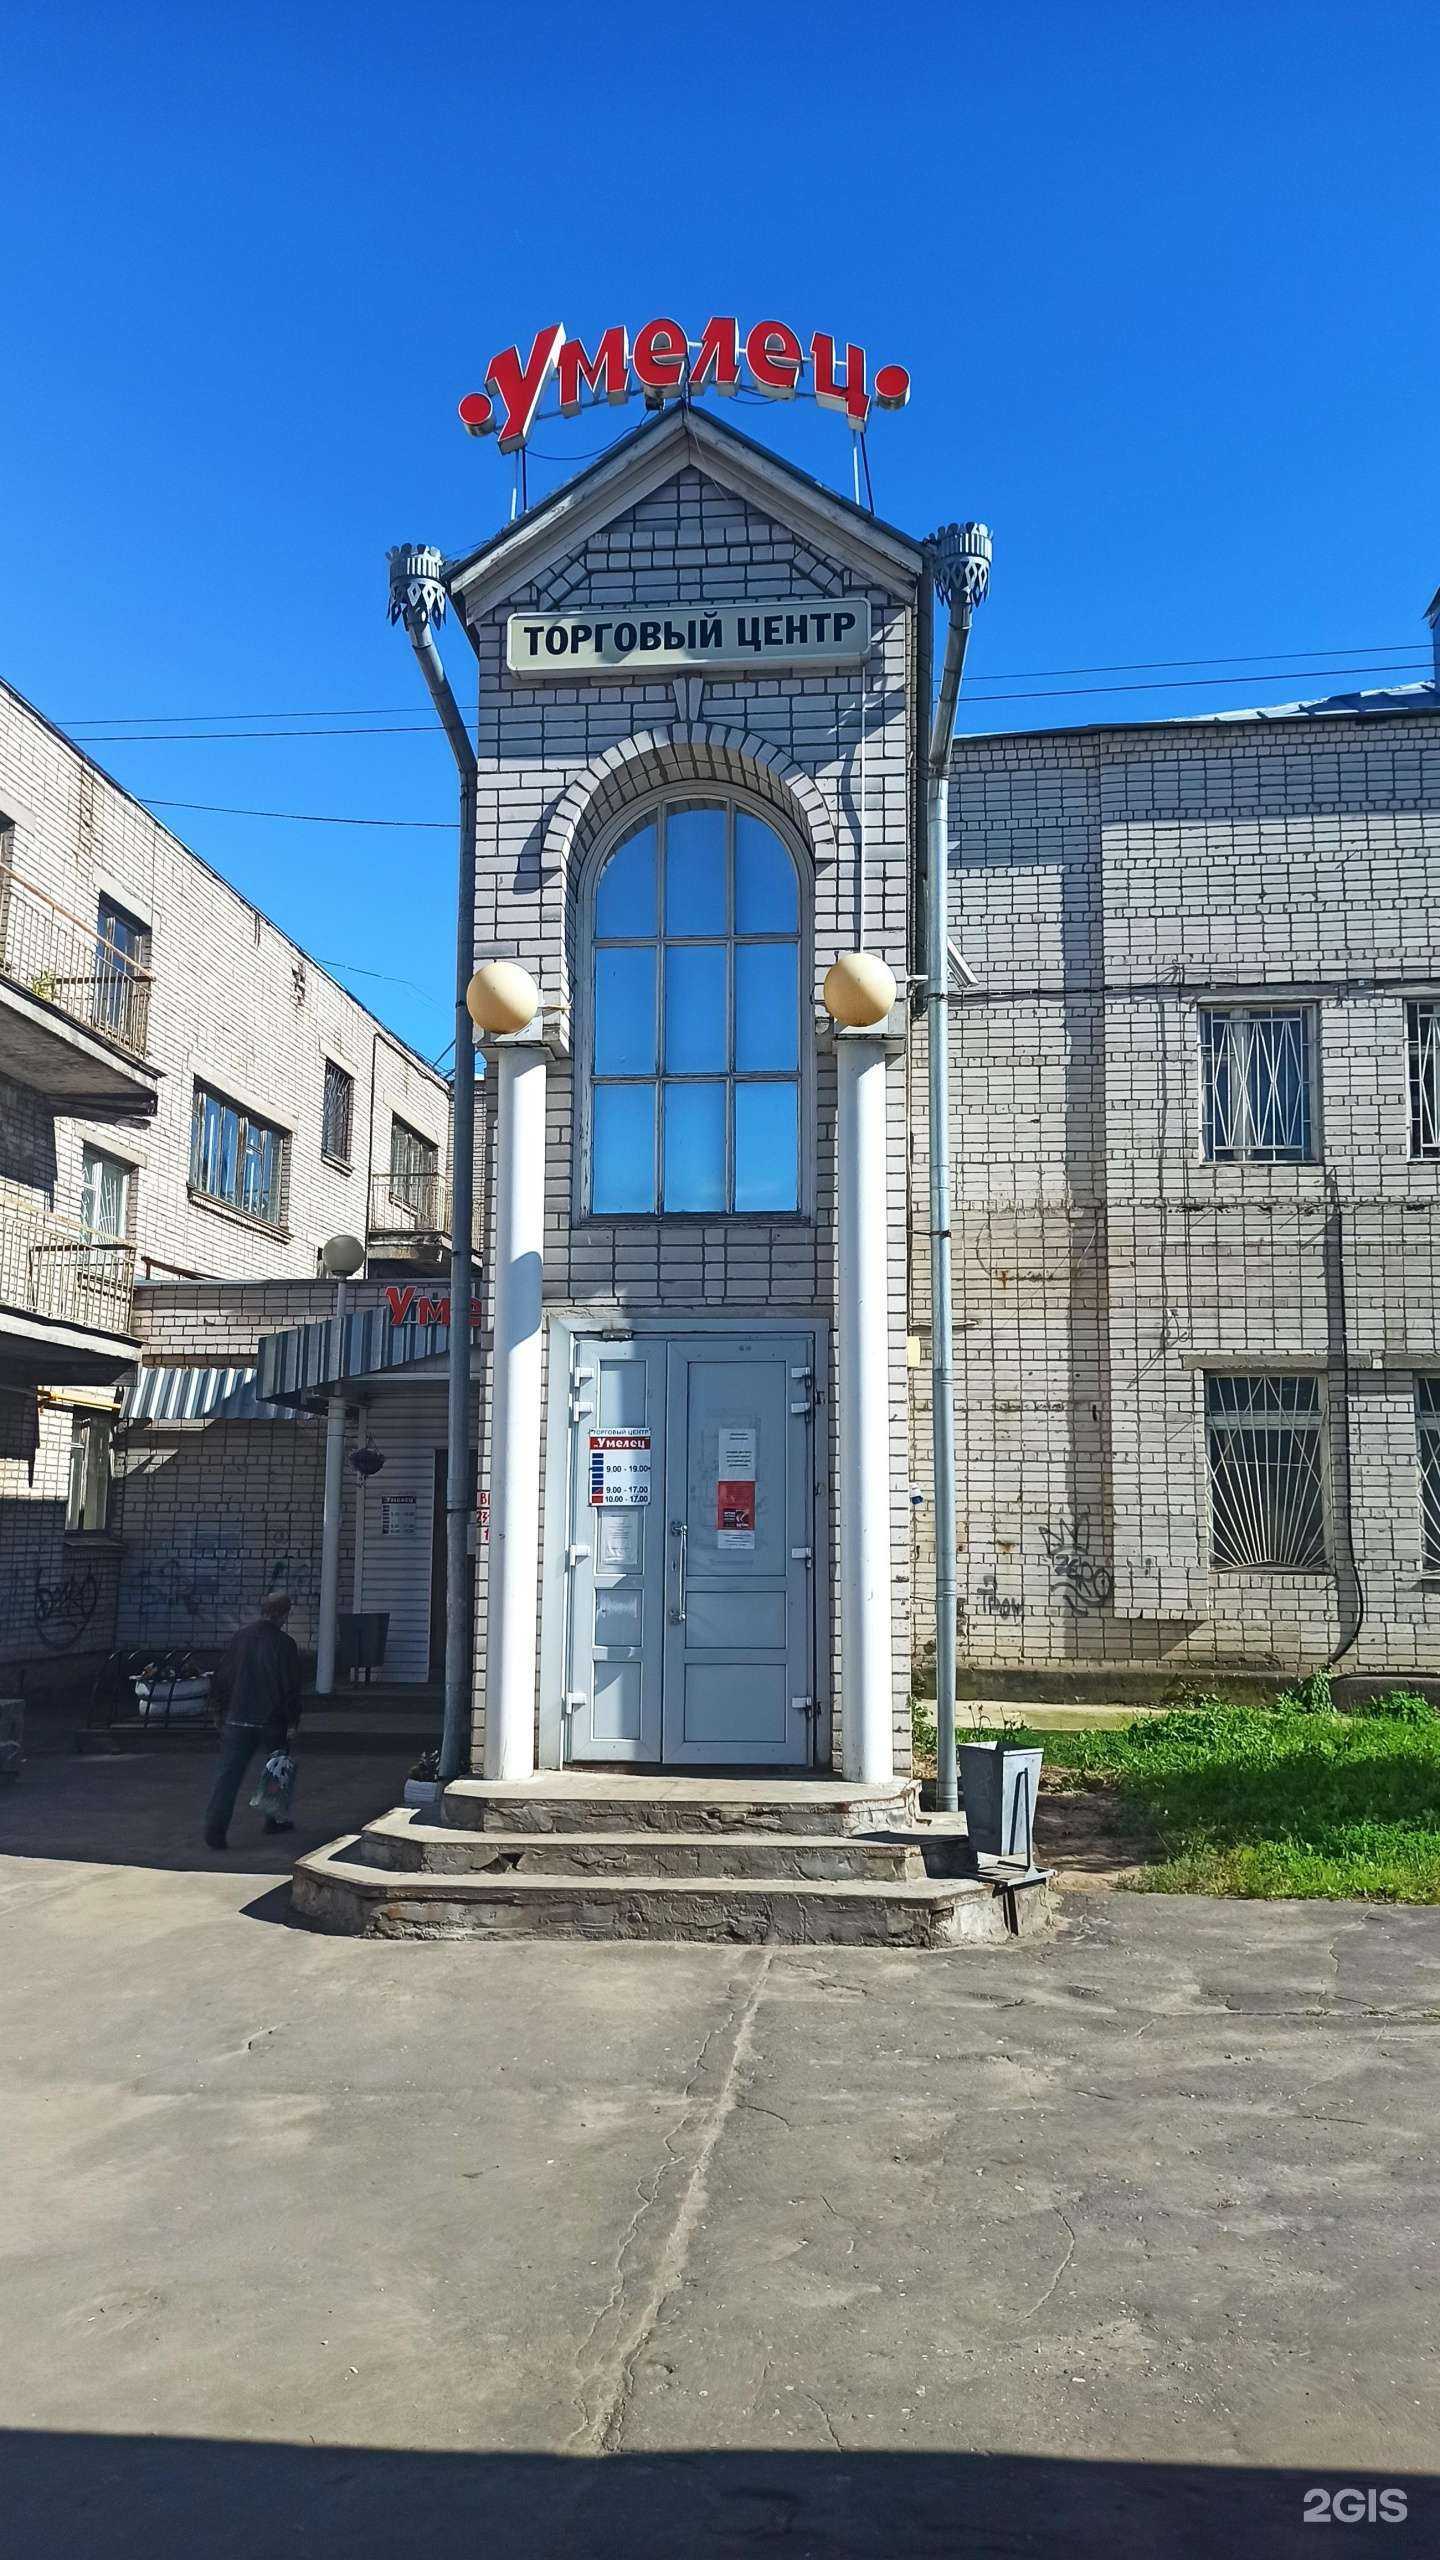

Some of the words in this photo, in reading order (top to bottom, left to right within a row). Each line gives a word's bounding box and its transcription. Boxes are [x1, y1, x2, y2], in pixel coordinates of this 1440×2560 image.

[522, 610, 723, 656] ТОРГОВЫЙ
[737, 611, 856, 652] ЦЕНТР
[606, 1465, 622, 1473] 9.00
[629, 1465, 648, 1473] 19.00
[606, 1486, 622, 1494] 9.00
[629, 1486, 648, 1494] 17.00
[605, 1495, 623, 1503] 10.00
[630, 1495, 648, 1503] 17.00
